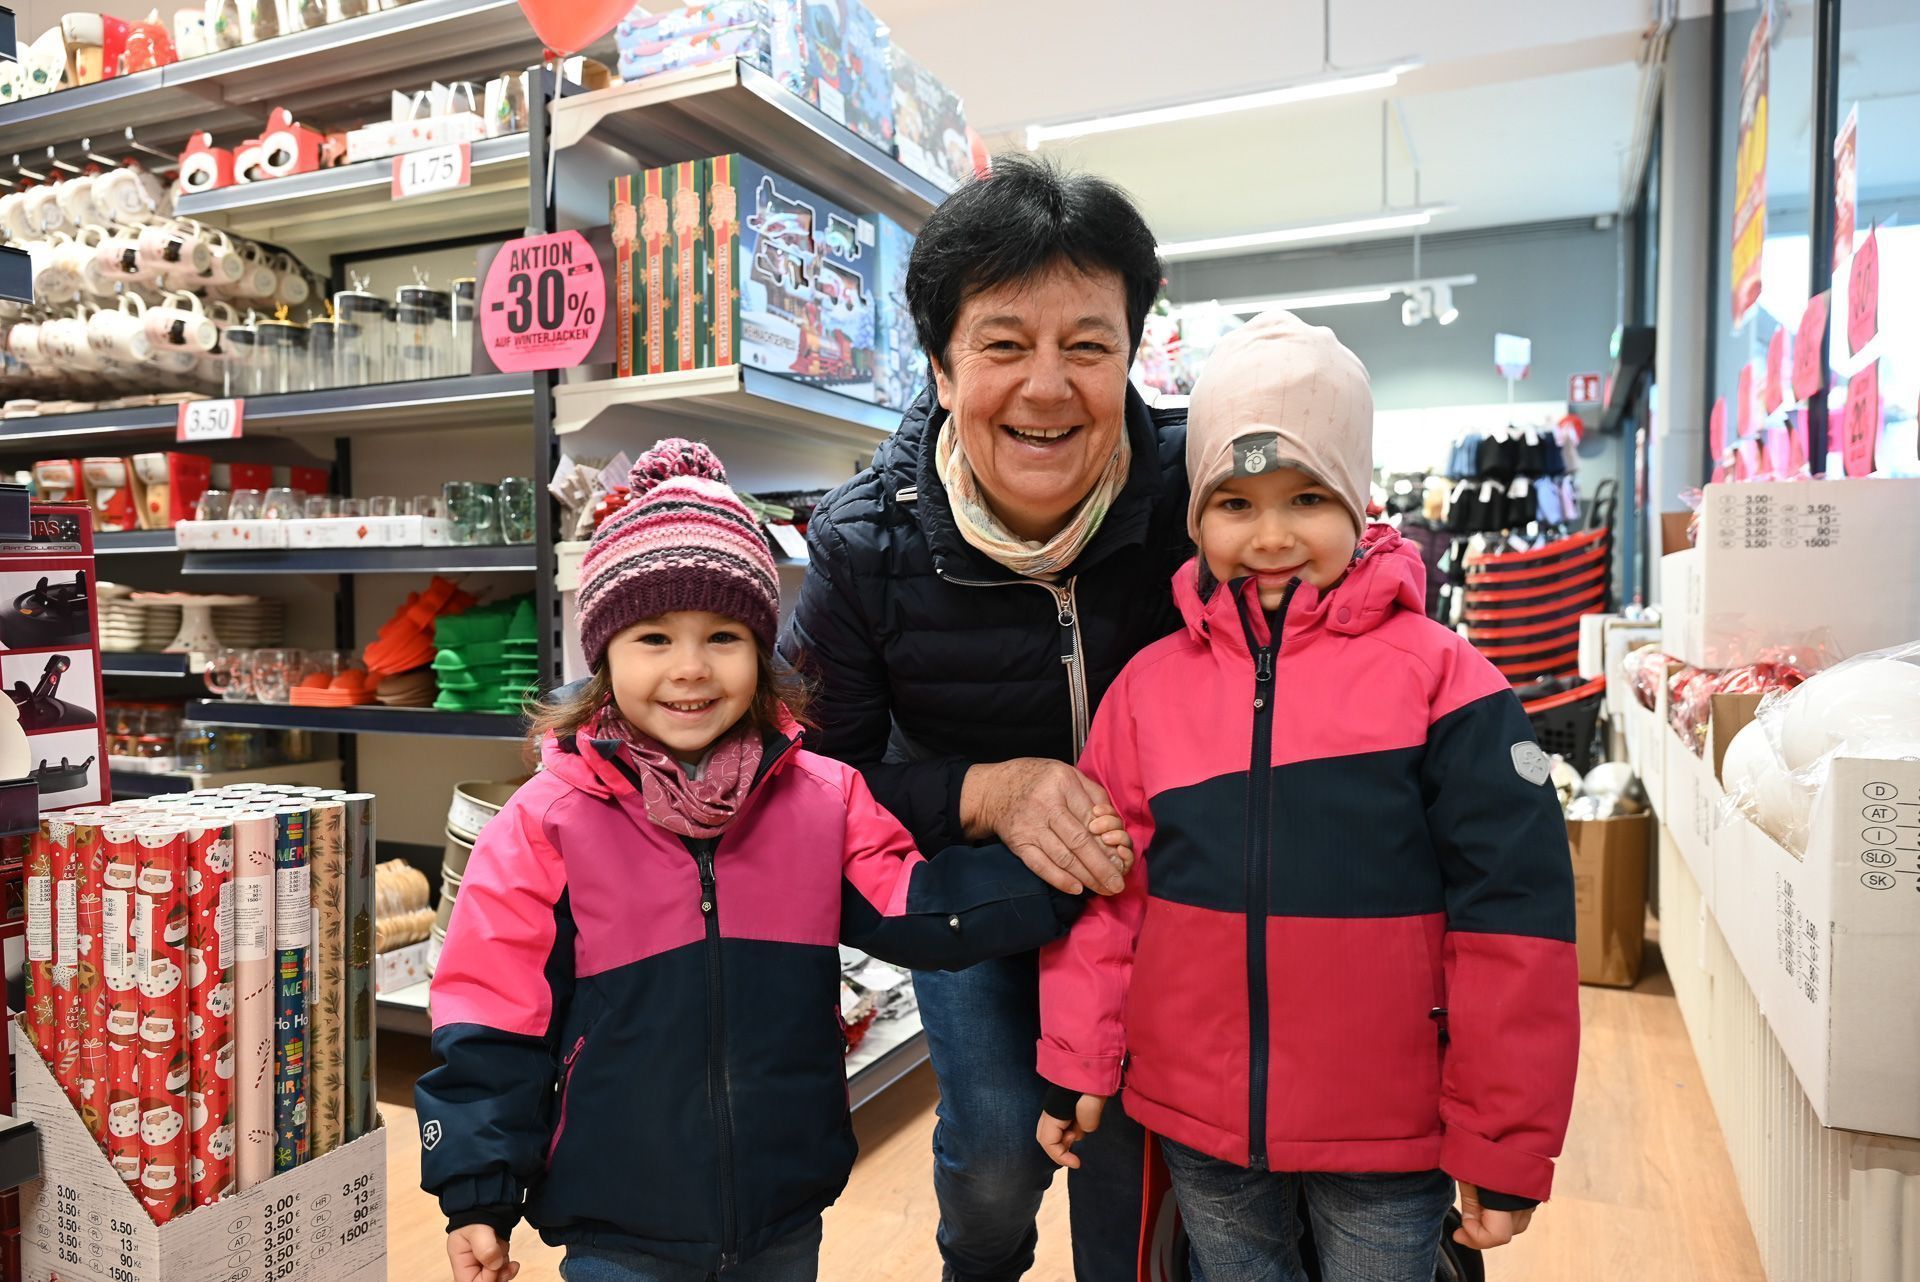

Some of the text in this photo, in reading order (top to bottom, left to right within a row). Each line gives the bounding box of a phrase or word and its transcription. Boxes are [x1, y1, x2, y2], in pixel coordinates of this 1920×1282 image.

[410, 153, 454, 185] 1.75
[510, 241, 573, 272] AKTION
[495, 336, 511, 348] AUF
[189, 407, 229, 432] 3.50
[1745, 495, 1768, 504] 3.00
[1745, 506, 1768, 515] 3.50
[1807, 504, 1831, 514] 3.50
[1745, 517, 1768, 527] 3.50
[1818, 516, 1831, 525] 13
[1745, 528, 1768, 537] 3.50
[1817, 527, 1831, 536] 90
[1745, 539, 1768, 549] 3.50
[1804, 538, 1831, 548] 1500
[1875, 786, 1886, 796] D
[1871, 808, 1888, 819] AT
[1877, 831, 1881, 841] I
[1865, 852, 1892, 864] SLO
[1869, 875, 1888, 887] SK
[294, 1013, 310, 1029] Ho
[57, 1185, 76, 1201] 3.00
[342, 1174, 368, 1197] 3.50
[315, 1197, 328, 1208] HR
[354, 1190, 369, 1207] 13
[57, 1200, 77, 1217] 3.50
[236, 1220, 243, 1230] D
[264, 1194, 294, 1218] 3.00
[353, 1206, 369, 1222] 90
[57, 1216, 77, 1233] 3.50
[316, 1213, 327, 1224] PL
[110, 1219, 133, 1236] 3.50
[234, 1236, 246, 1248] AT
[264, 1211, 294, 1235] 3.50
[315, 1229, 328, 1240] CZ
[339, 1221, 369, 1246] 1500
[58, 1232, 77, 1249] 3.50
[120, 1238, 133, 1252] 13
[264, 1227, 294, 1252] 3.50
[58, 1247, 78, 1265] 3.50
[318, 1246, 325, 1256] H
[120, 1253, 133, 1268] 90
[231, 1269, 249, 1282] SLO
[264, 1244, 294, 1268] 3.50
[109, 1266, 133, 1282] 1500
[264, 1261, 294, 1282] 3.50
